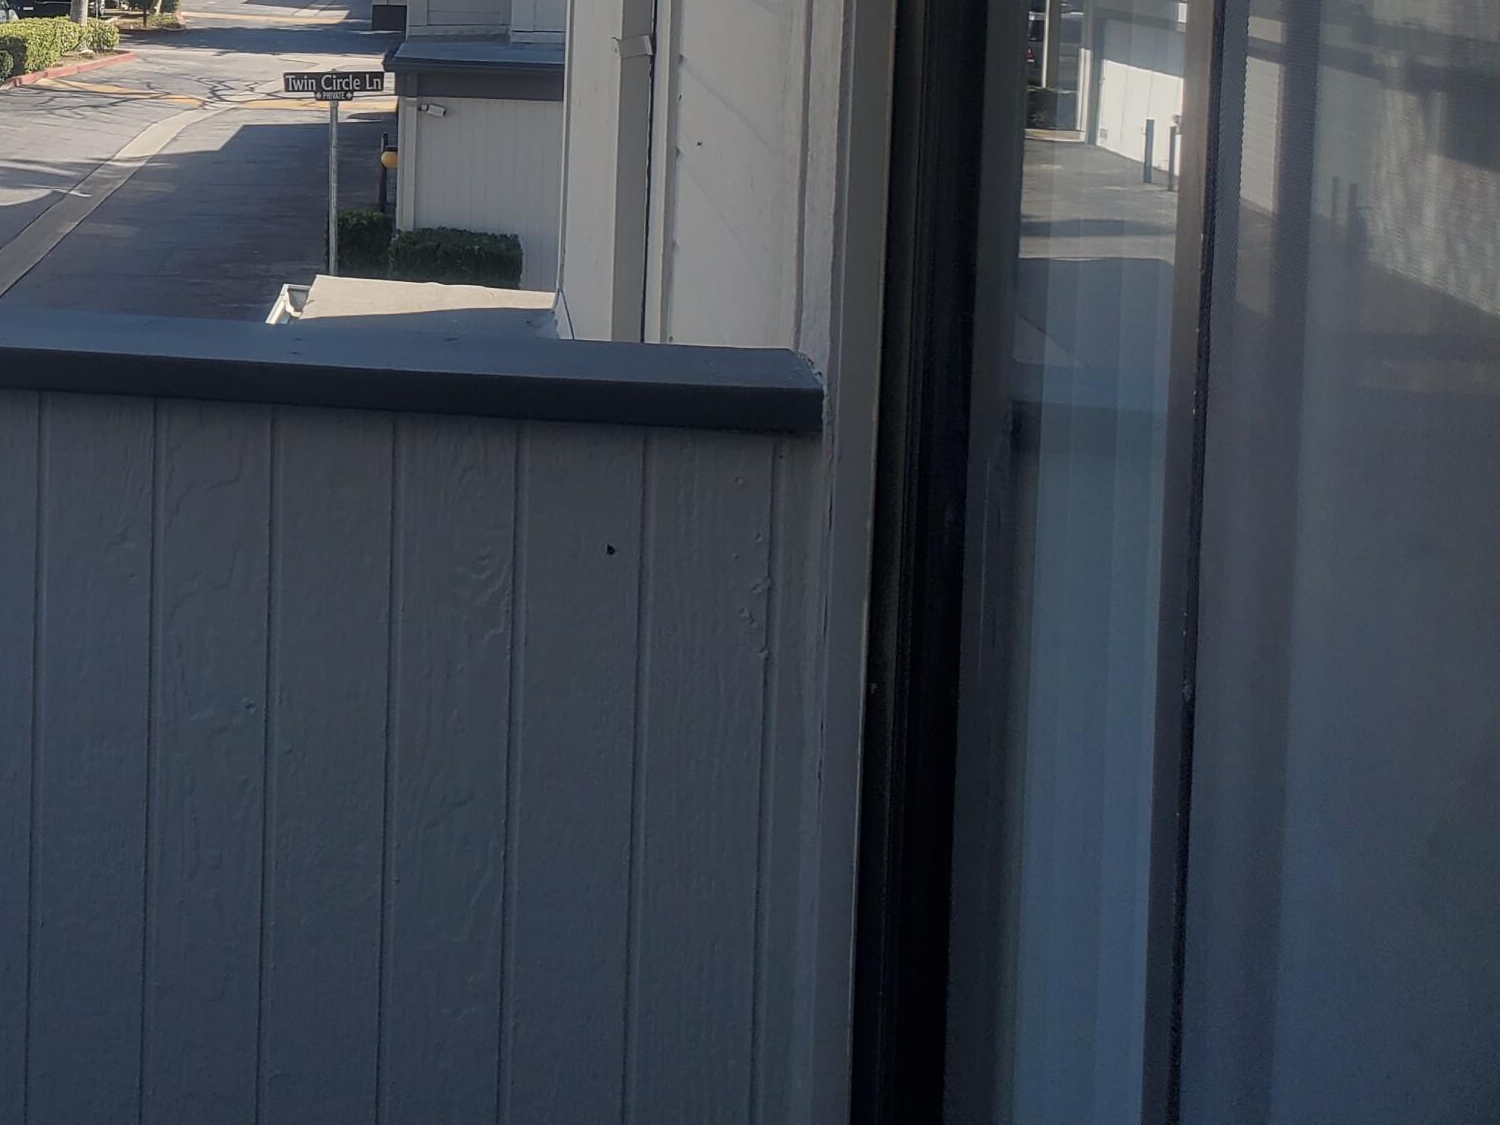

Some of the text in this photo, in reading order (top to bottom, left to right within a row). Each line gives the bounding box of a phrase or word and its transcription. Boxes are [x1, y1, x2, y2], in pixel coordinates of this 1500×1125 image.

[285, 74, 382, 91] Twin Circle Ln
[322, 91, 346, 100] PRIVATE
